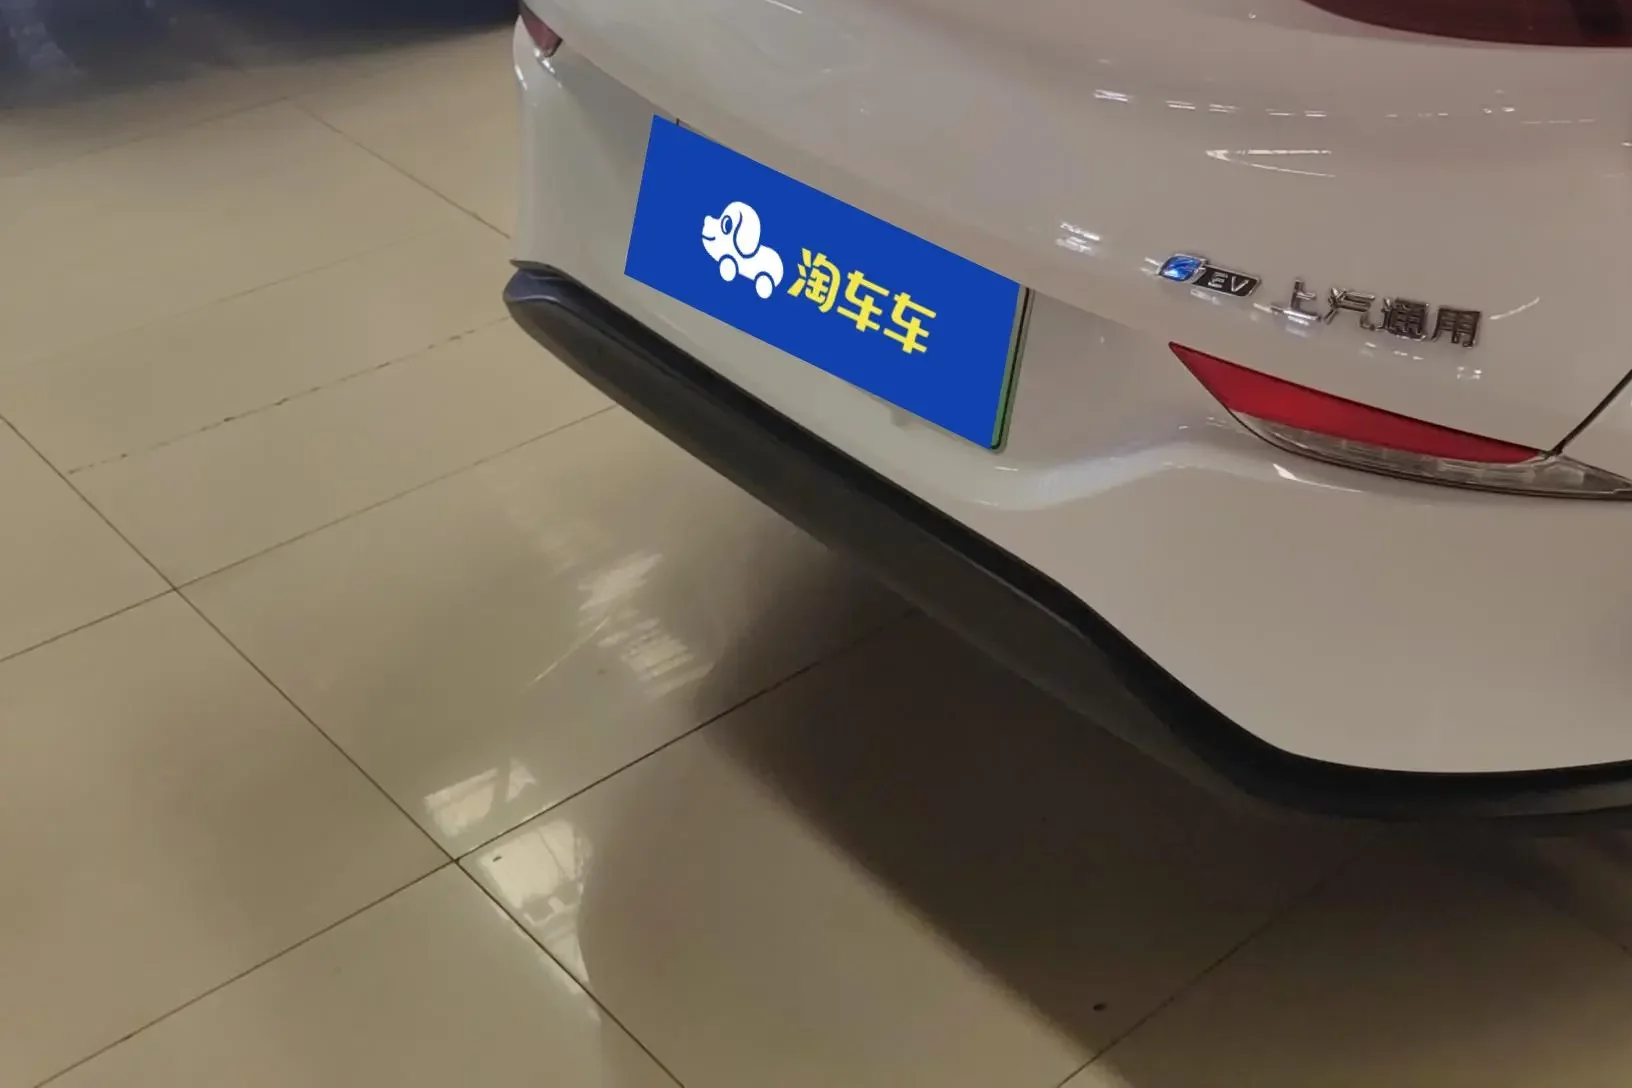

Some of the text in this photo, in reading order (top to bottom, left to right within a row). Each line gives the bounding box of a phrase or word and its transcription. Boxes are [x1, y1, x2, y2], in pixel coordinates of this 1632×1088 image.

[1207, 272, 1249, 293] EV
[1271, 276, 1481, 348] 上汽通用
